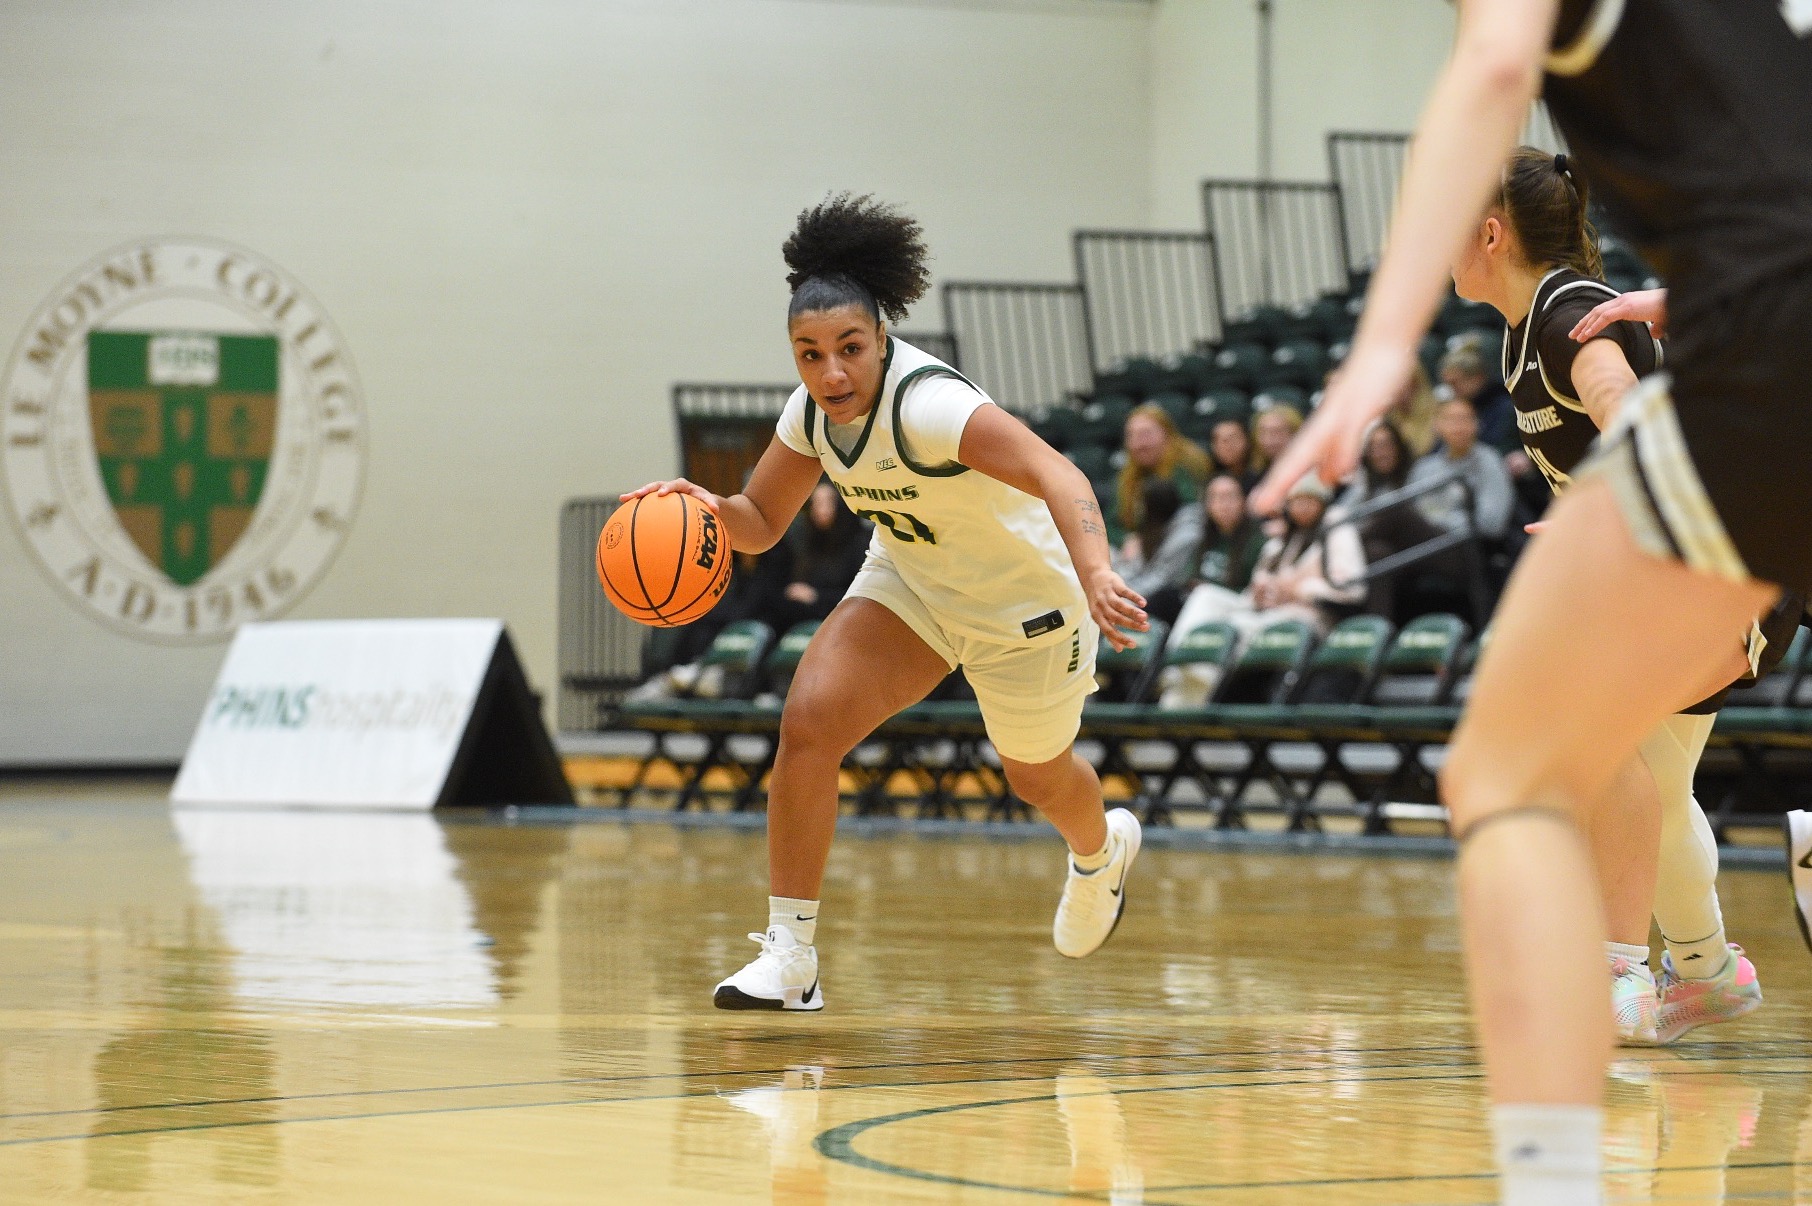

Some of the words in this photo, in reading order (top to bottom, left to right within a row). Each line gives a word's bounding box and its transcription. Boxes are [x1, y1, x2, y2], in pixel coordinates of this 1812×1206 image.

[26, 251, 157, 367] MOYNE
[216, 252, 354, 444] COLLEGE
[696, 508, 718, 570] NCAA
